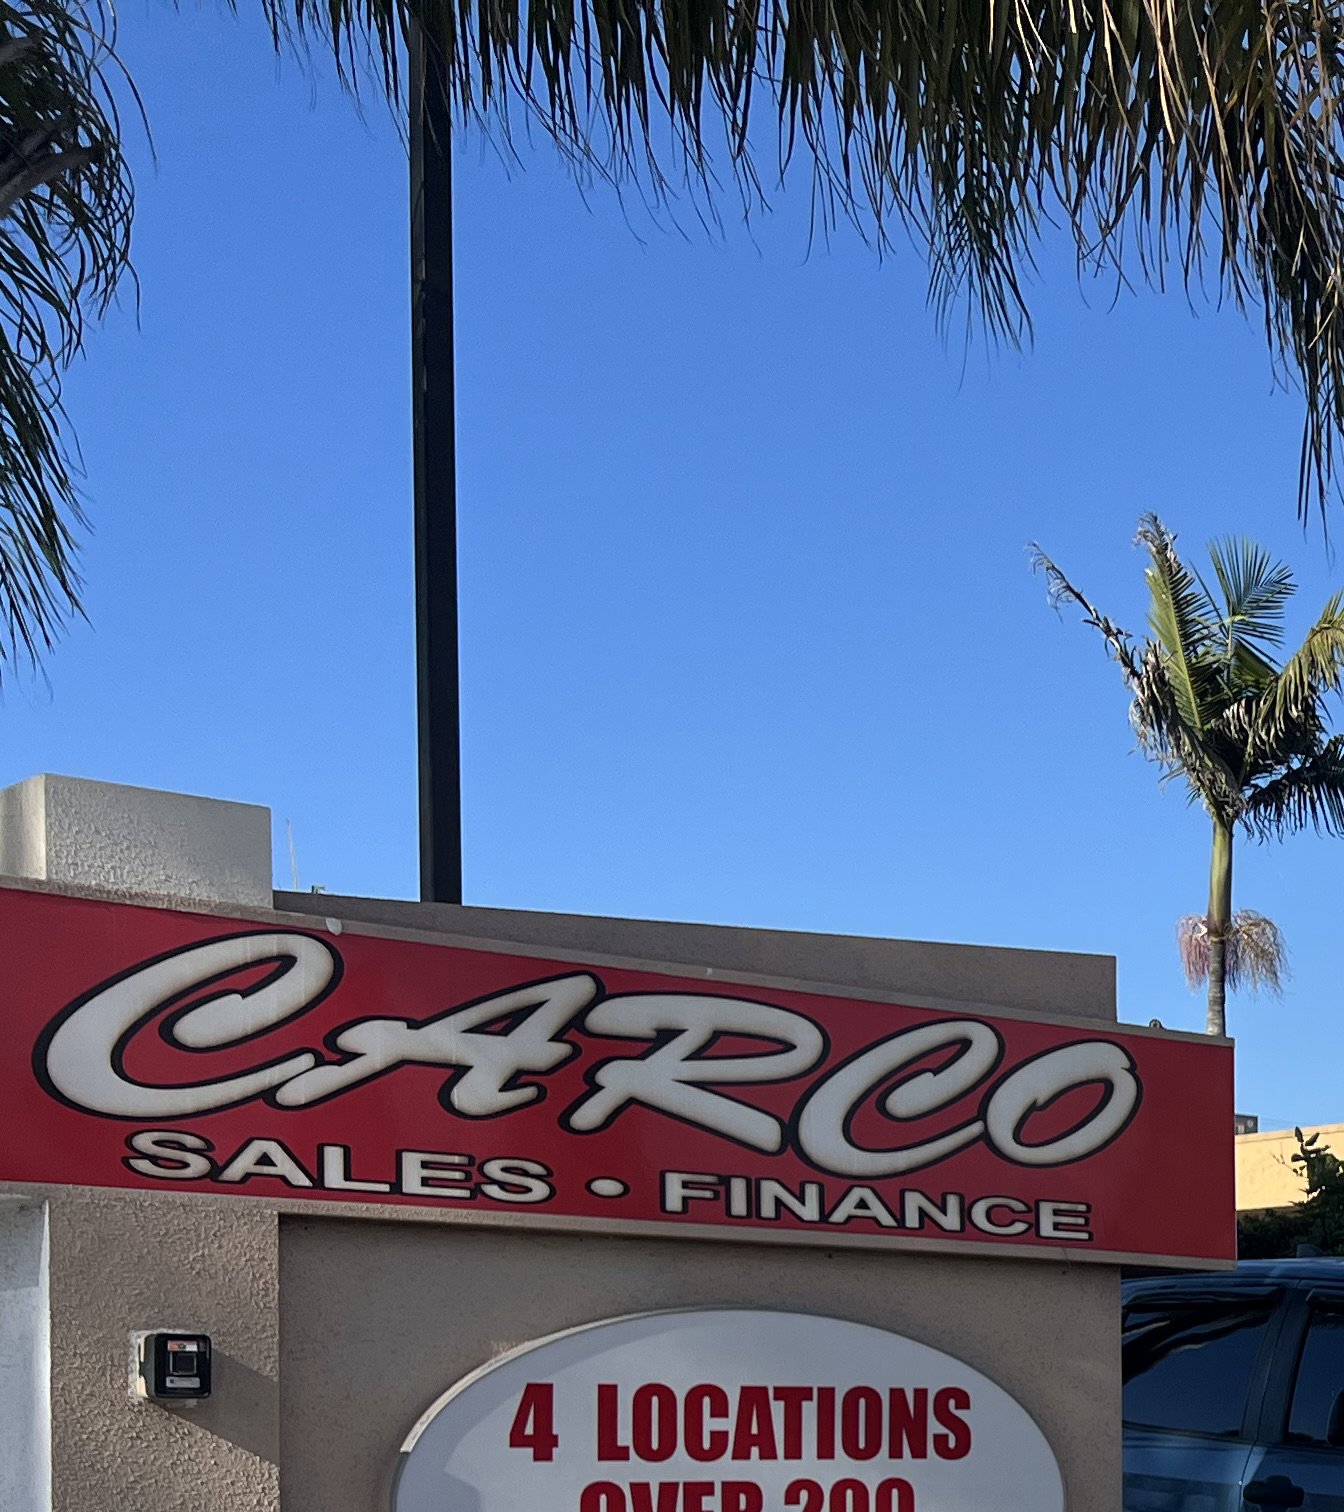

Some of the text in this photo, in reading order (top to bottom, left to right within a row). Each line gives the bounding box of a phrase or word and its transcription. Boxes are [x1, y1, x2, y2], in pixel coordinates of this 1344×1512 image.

[32, 930, 1142, 1178] CARCO
[125, 1130, 1094, 1241] SALES FINANCE
[509, 1382, 972, 1463] 4 LOCATIONS
